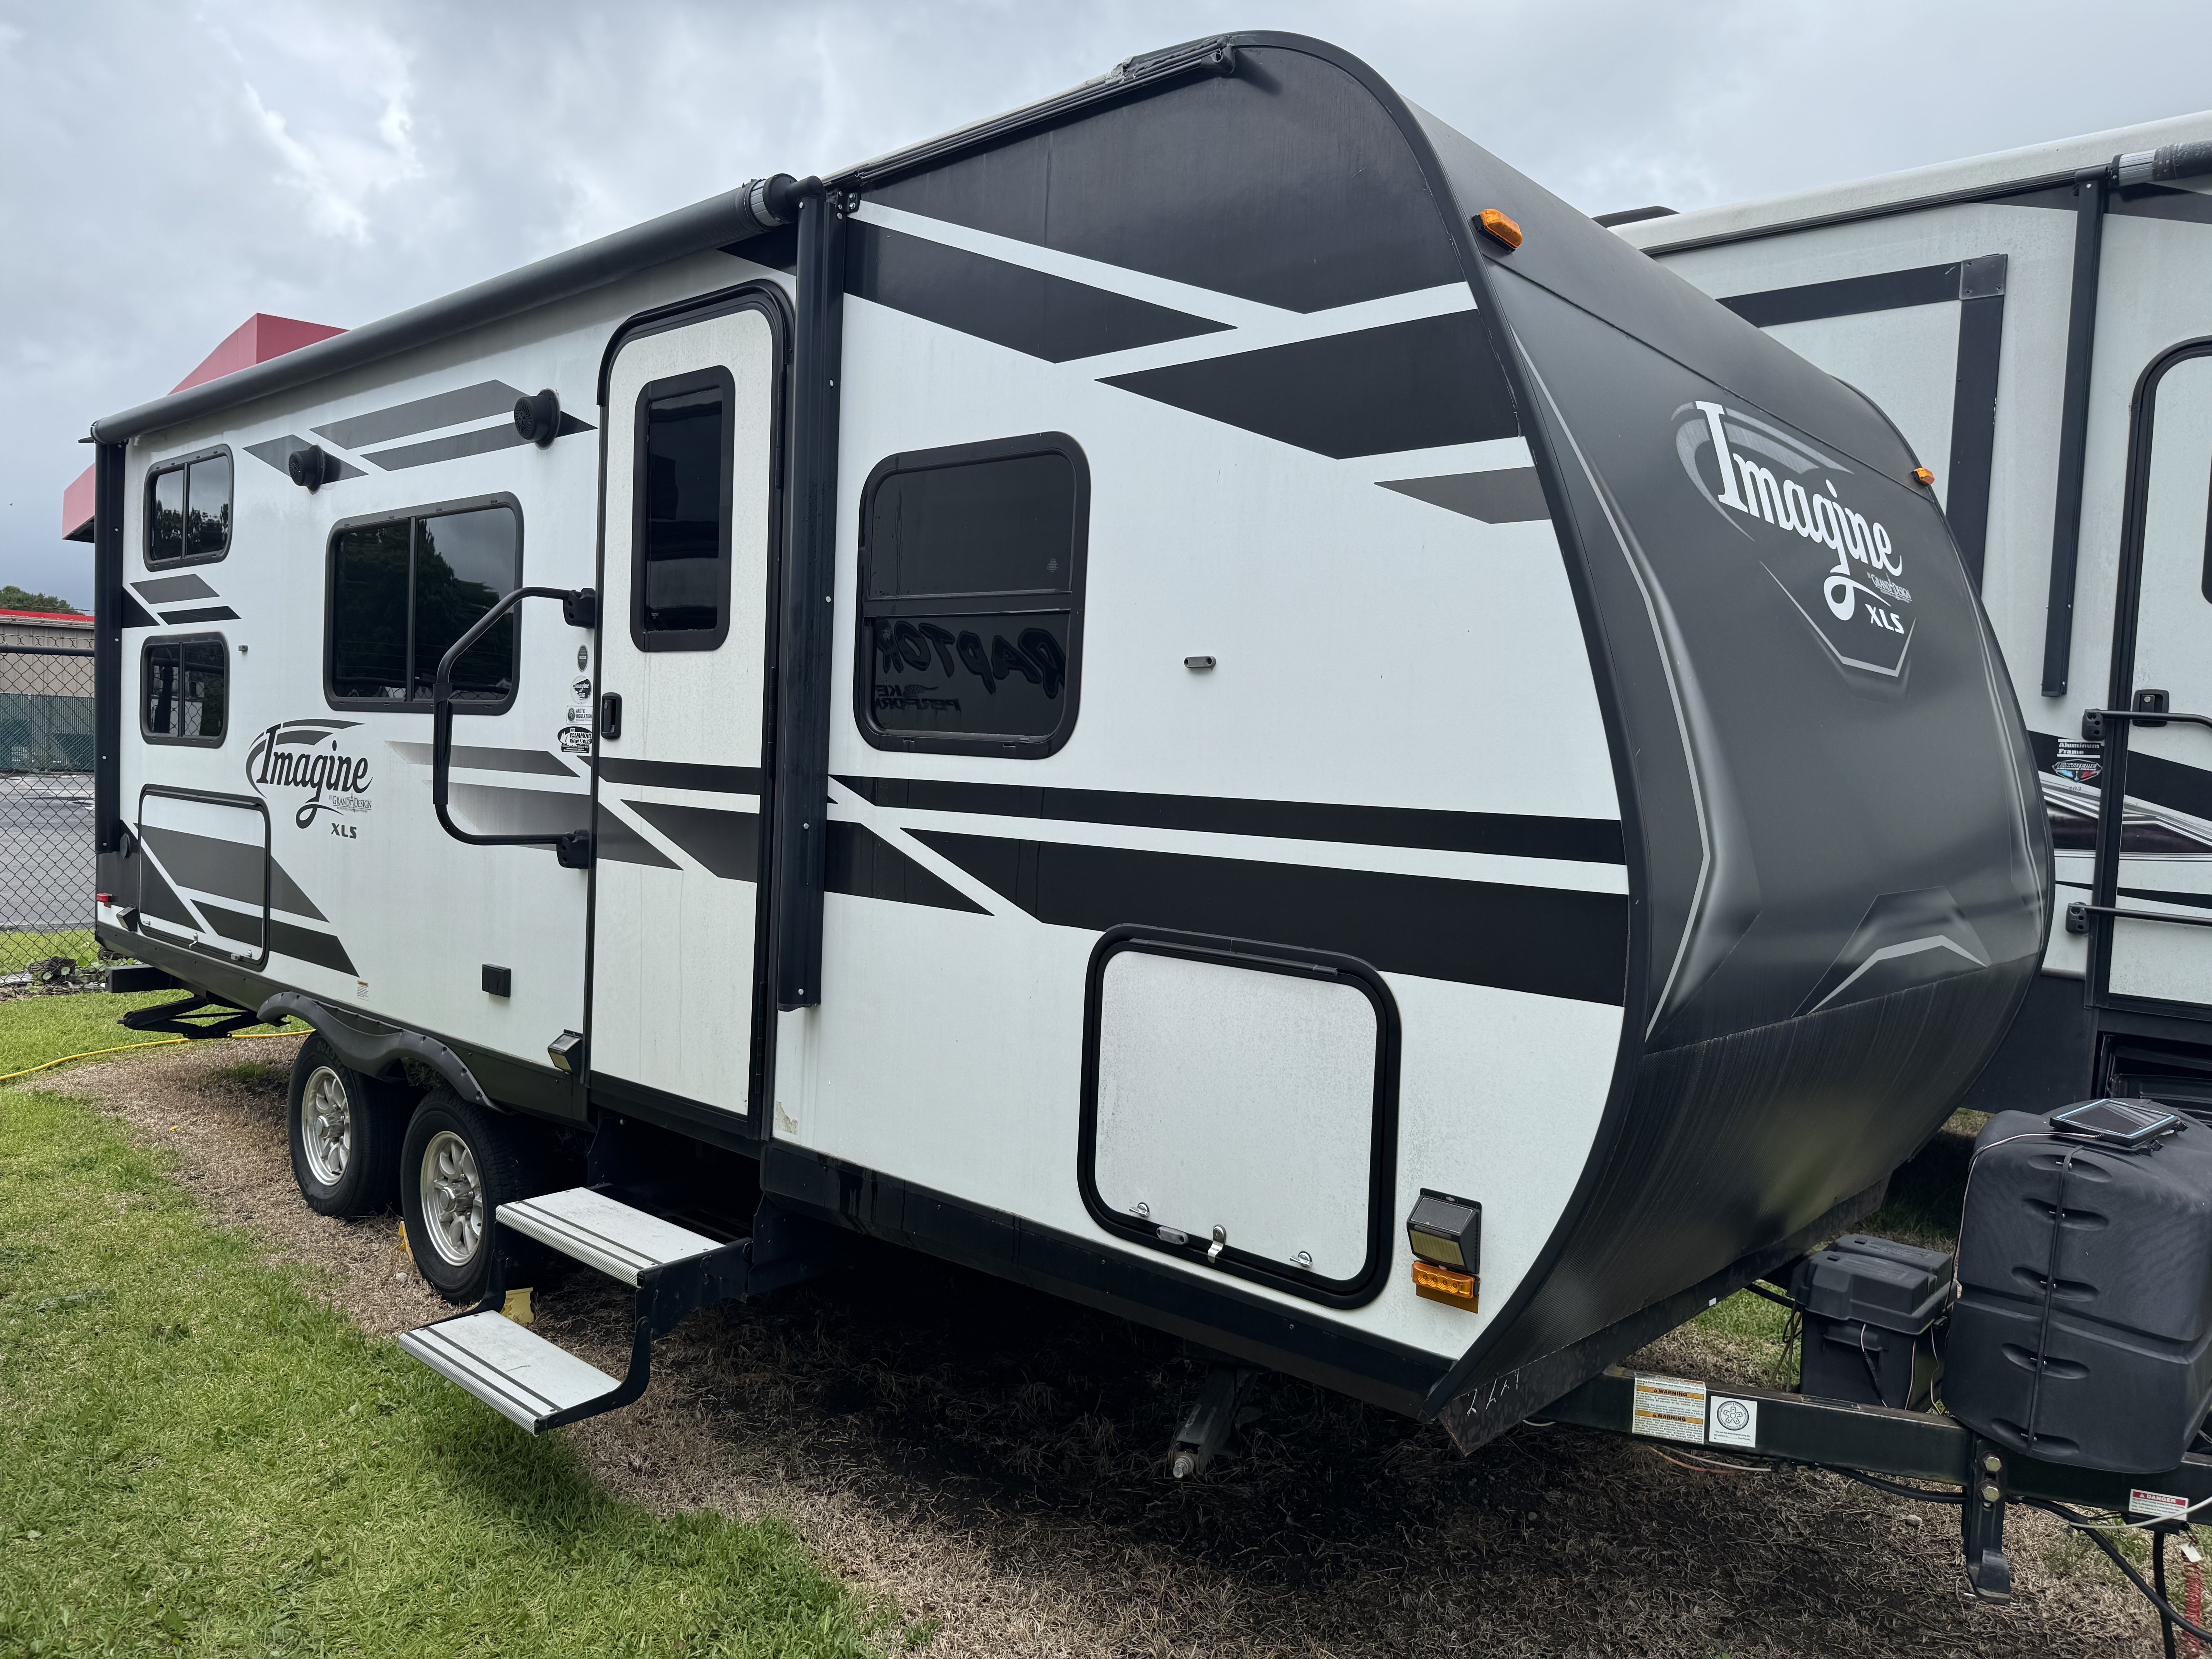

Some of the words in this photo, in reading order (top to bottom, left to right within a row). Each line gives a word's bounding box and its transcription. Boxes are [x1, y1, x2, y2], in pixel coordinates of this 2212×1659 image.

[1695, 400, 1902, 620] Imagine
[1865, 603, 1904, 634] XLS
[256, 723, 373, 829] Imagine
[332, 795, 350, 806] GRAND
[354, 798, 372, 809] DESIGN
[331, 823, 357, 839] XLS
[1657, 1413, 1686, 1422] WARNING
[2146, 1494, 2176, 1503] DANGER
